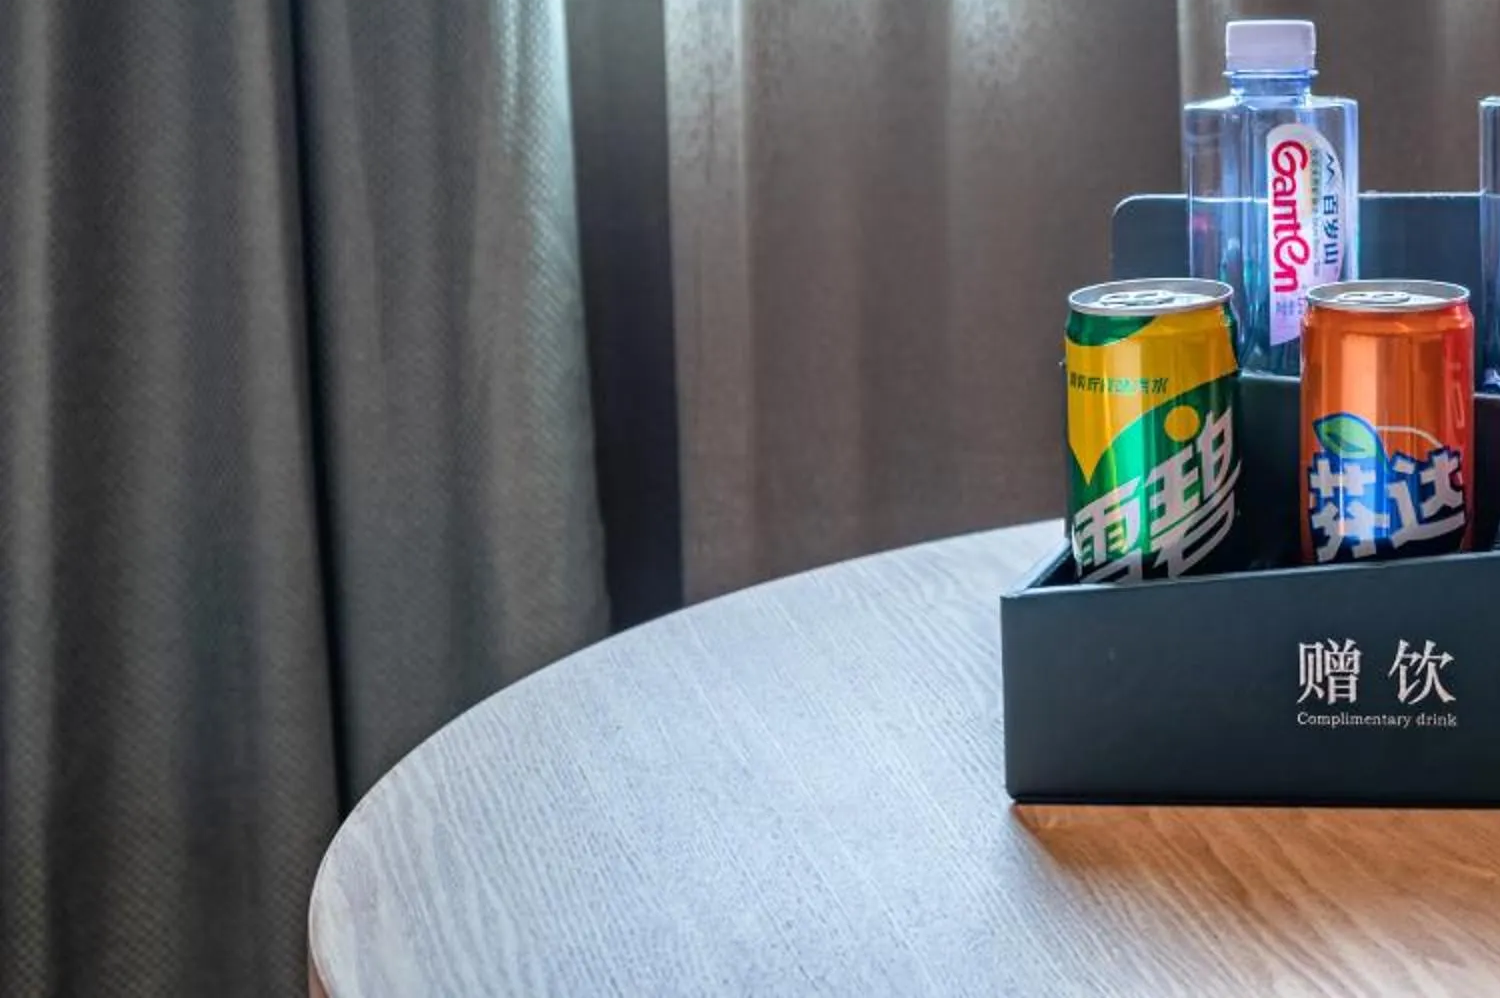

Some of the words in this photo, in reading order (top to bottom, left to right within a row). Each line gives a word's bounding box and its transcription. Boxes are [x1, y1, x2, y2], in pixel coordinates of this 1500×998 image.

[1322, 195, 1339, 265] 百岁山
[1072, 406, 1242, 584] 雪碧
[1310, 452, 1466, 563] 芬达
[1297, 711, 1411, 729] Complimentary
[1416, 712, 1457, 727] drink
